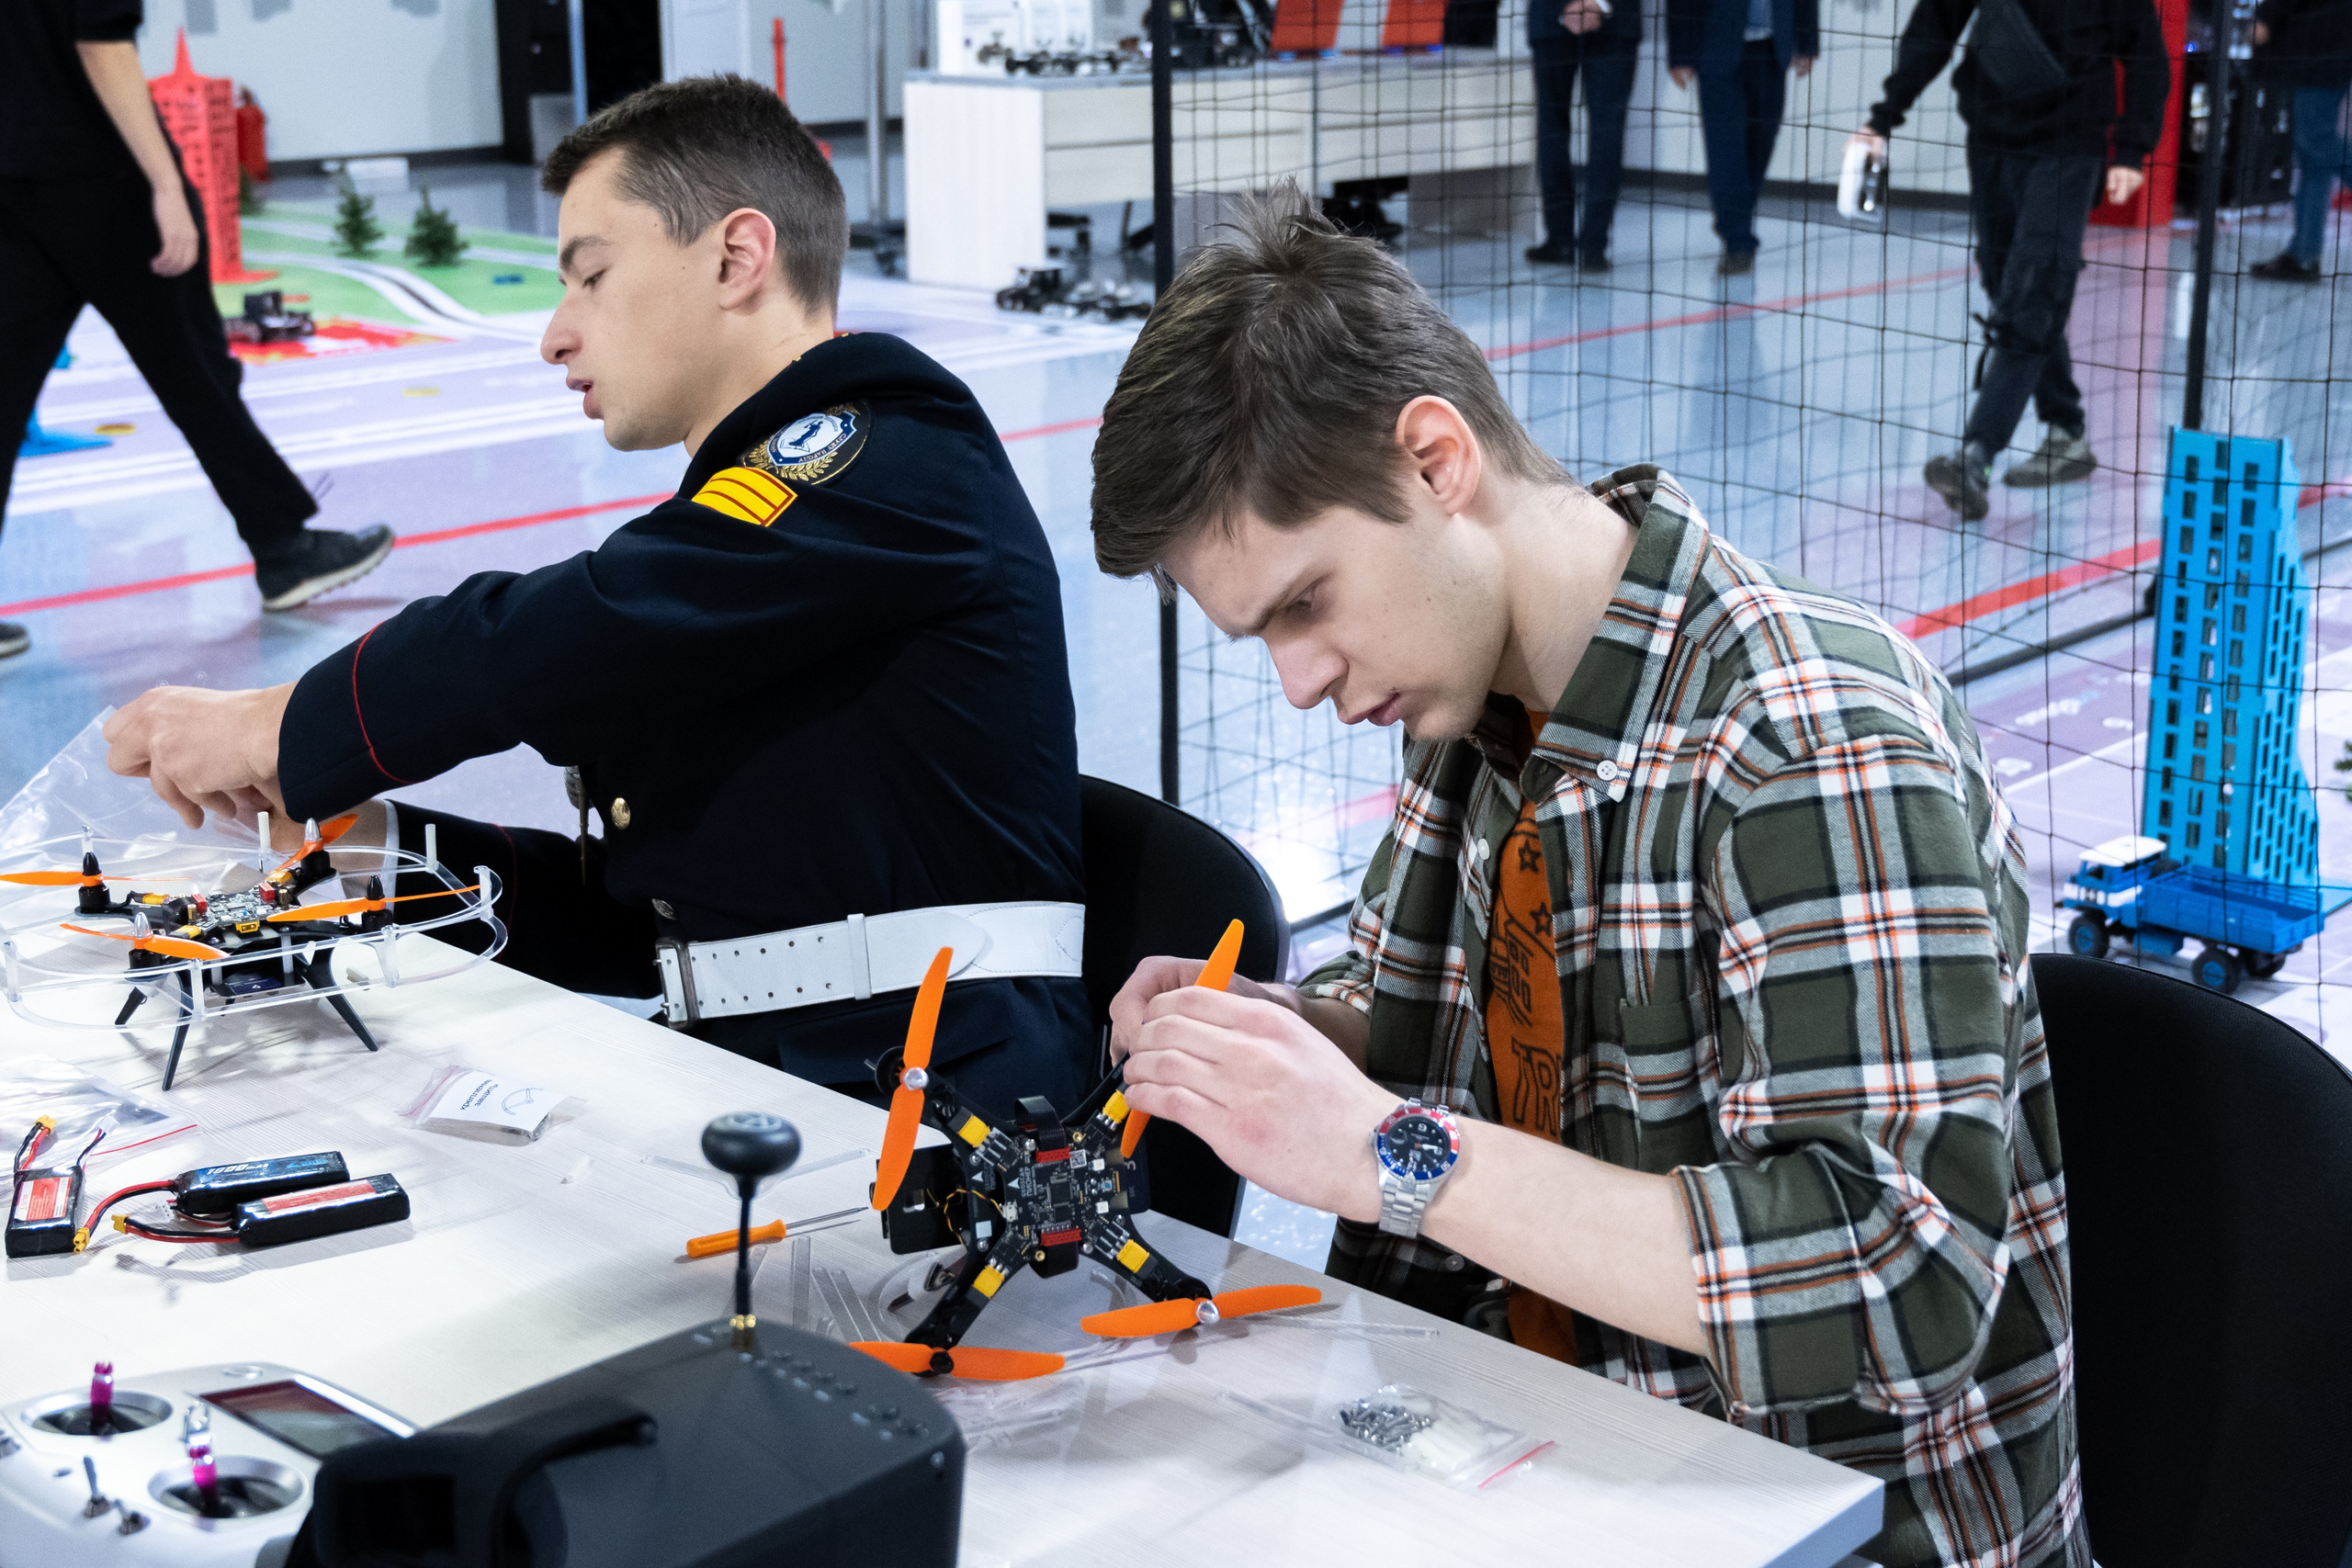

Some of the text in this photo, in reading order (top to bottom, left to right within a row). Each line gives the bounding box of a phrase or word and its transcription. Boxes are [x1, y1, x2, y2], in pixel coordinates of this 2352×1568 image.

[474, 1083, 499, 1107] защиты
[1511, 1034, 1562, 1137] TR
[1024, 1166, 1033, 1196] ПИОНЕР
